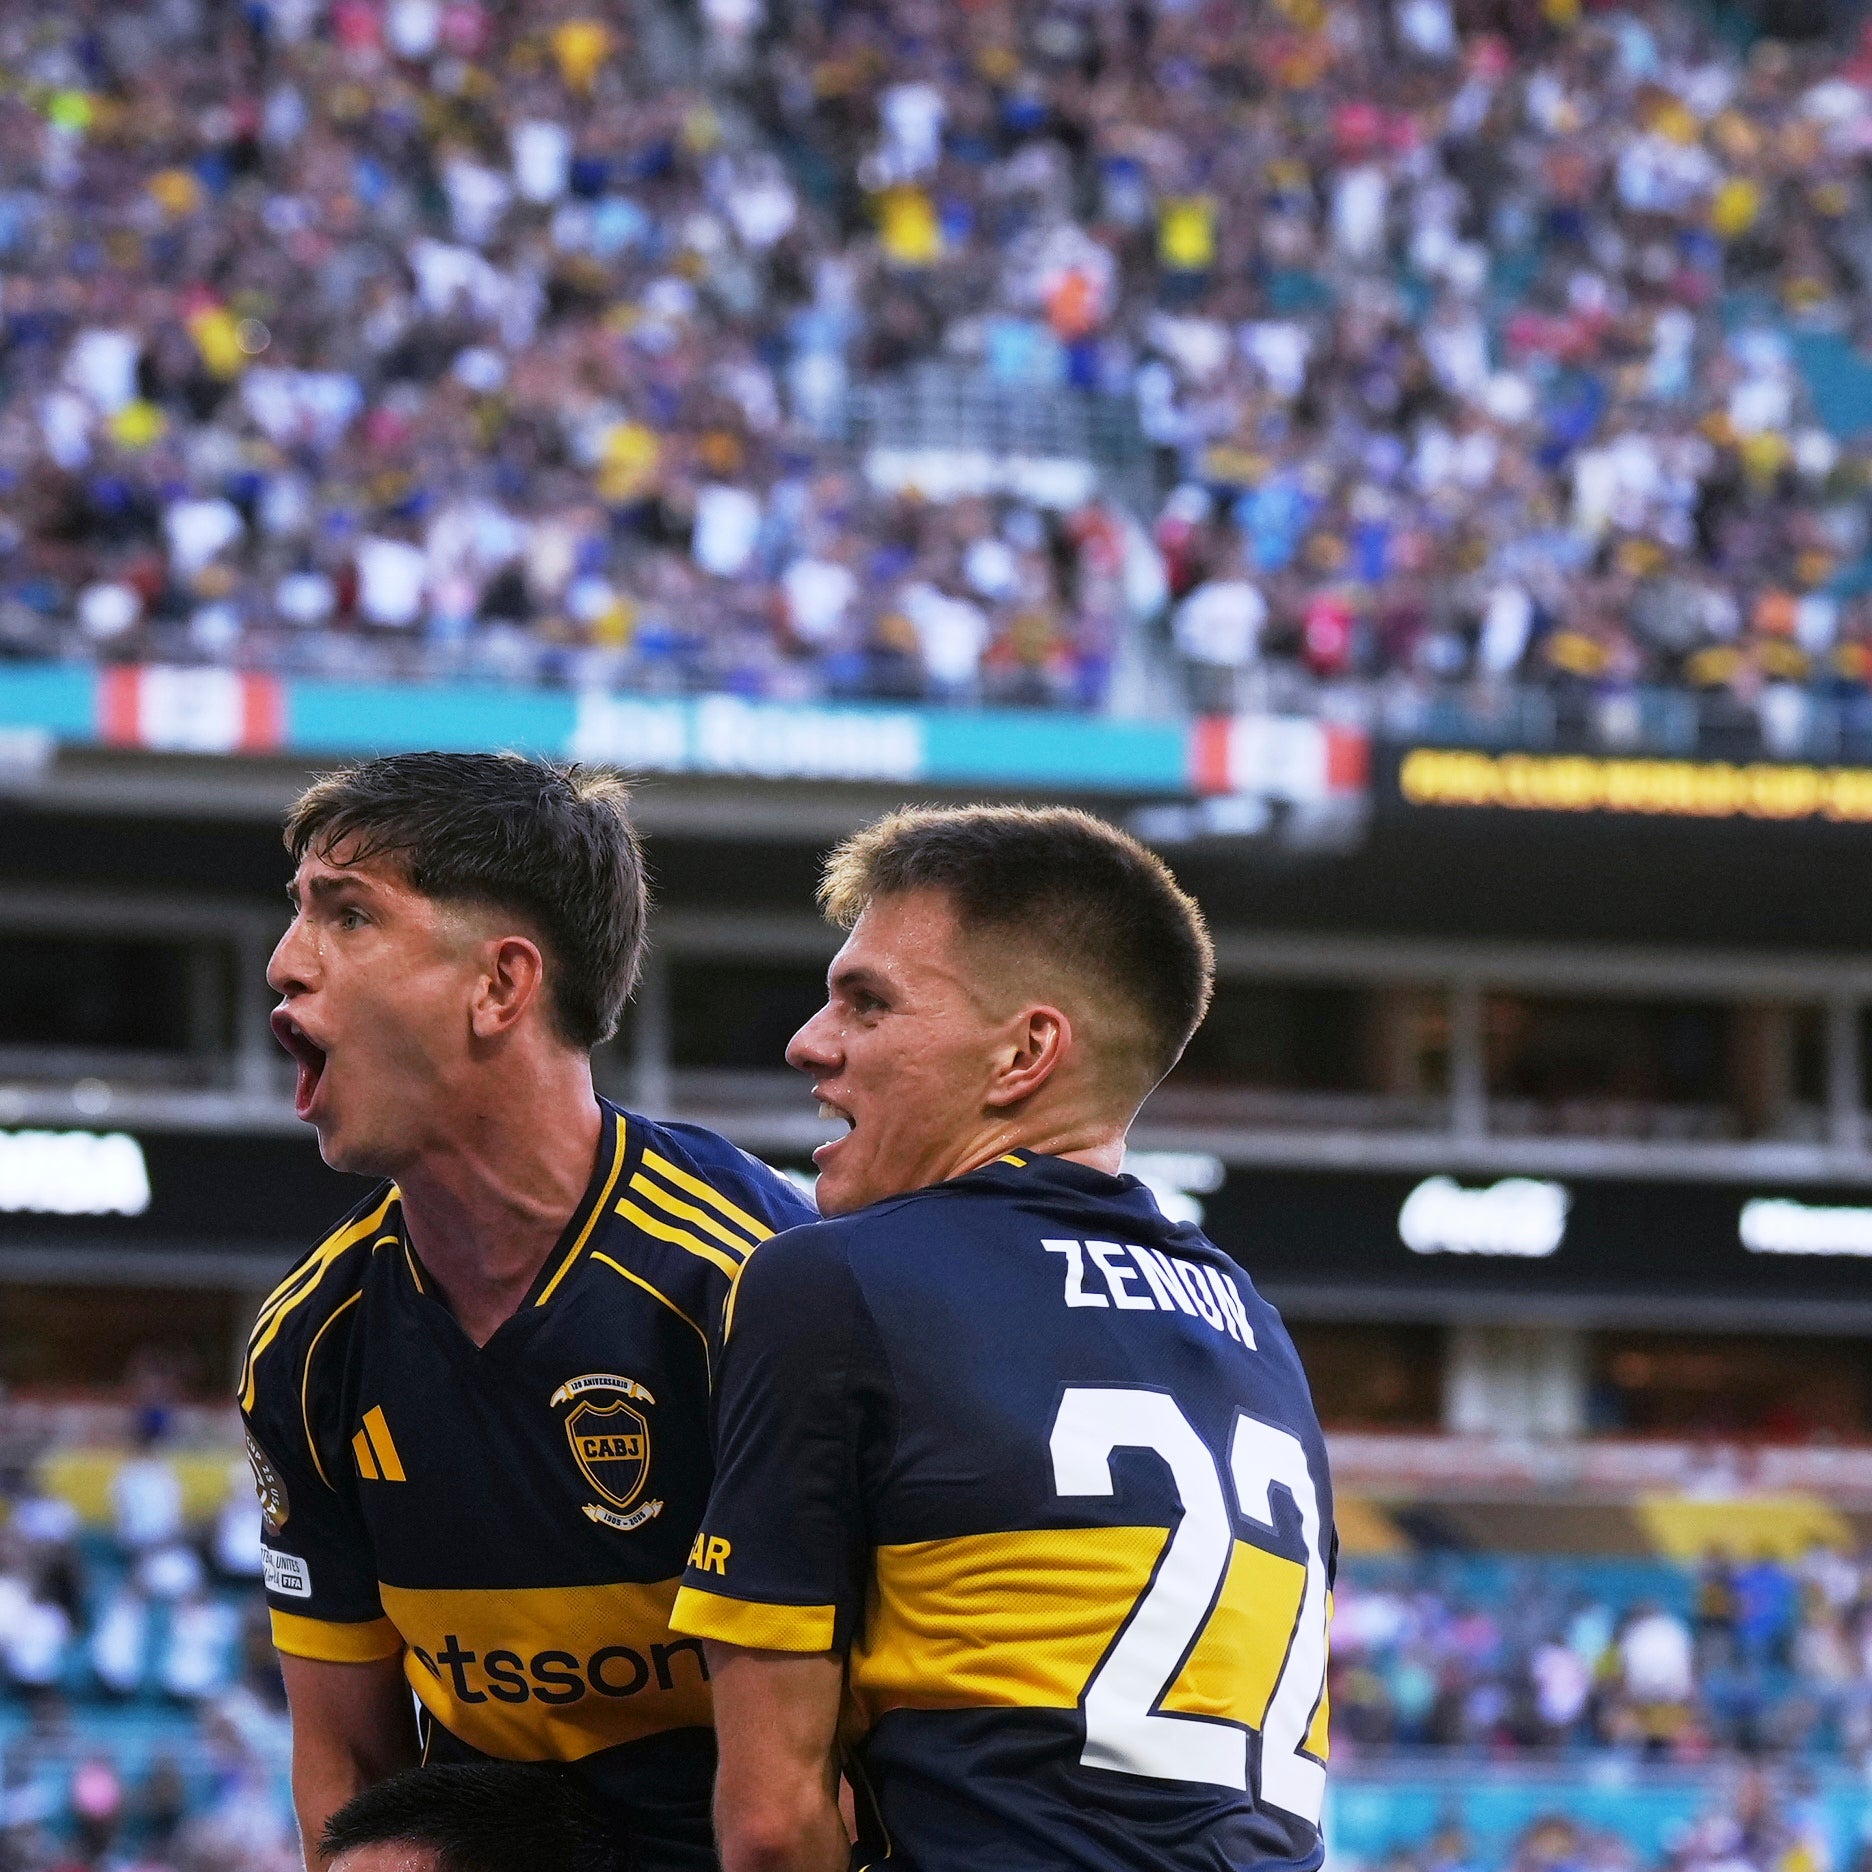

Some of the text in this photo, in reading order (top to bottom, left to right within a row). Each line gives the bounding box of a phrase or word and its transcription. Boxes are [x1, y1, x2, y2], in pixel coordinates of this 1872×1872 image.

[1041, 1239, 1258, 1351] ZENON
[583, 1438, 639, 1458] CABJ
[283, 1576, 302, 1589] FIFA
[1048, 1387, 1326, 1830] 22
